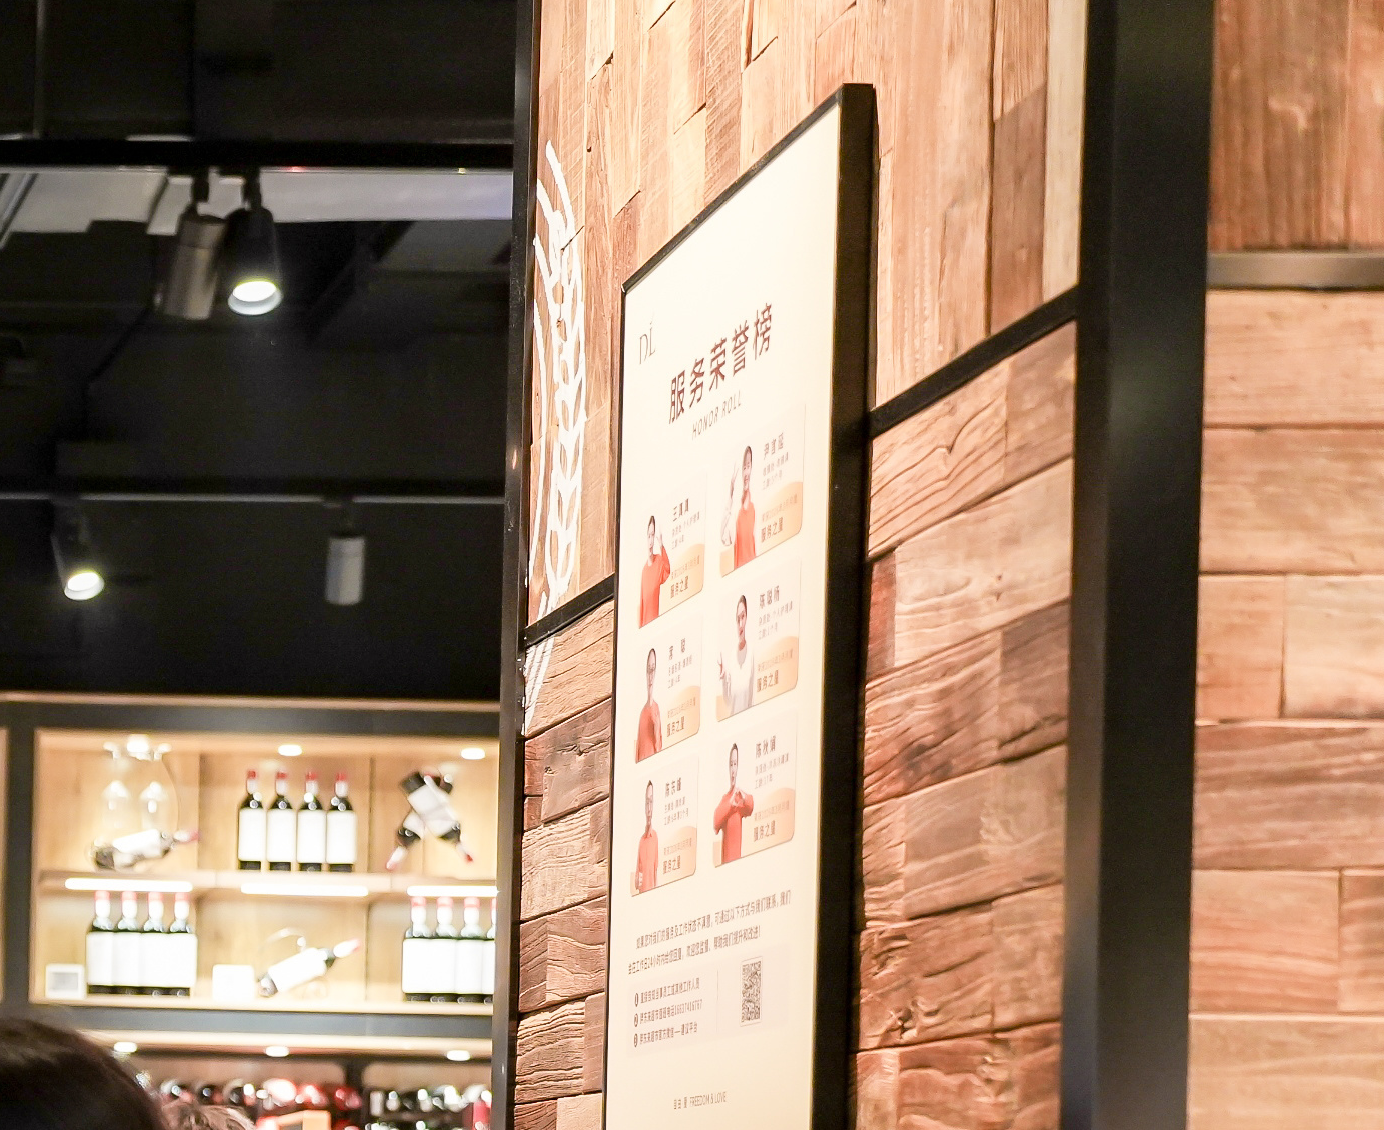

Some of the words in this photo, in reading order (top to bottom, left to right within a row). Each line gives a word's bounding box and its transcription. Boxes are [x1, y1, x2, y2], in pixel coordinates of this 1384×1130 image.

[669, 302, 772, 424] 服务荣誉榜
[692, 405, 719, 440] HONOR
[721, 390, 741, 418] ROLL
[760, 514, 784, 544] 服务之星
[669, 573, 689, 599] 服务之星
[756, 667, 779, 694] 服务之星
[666, 714, 685, 738] 服务之星
[752, 818, 776, 843] 服务之星
[662, 853, 681, 875] 服务之星
